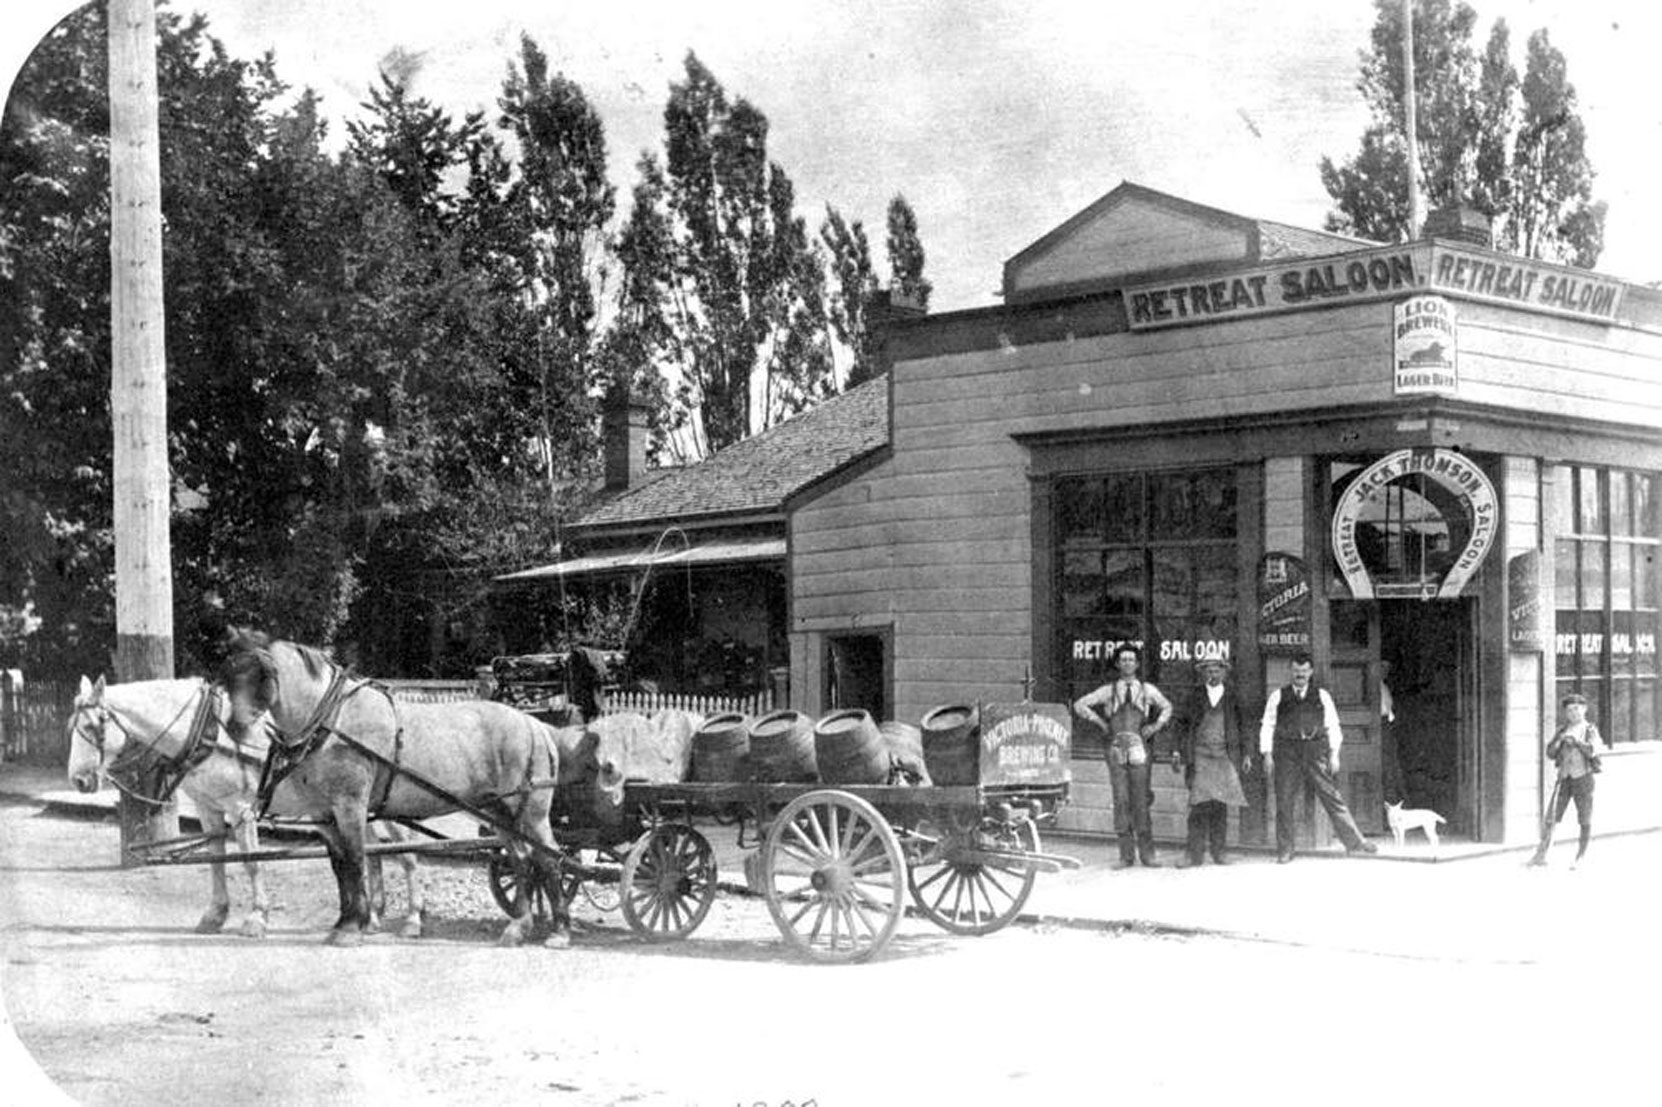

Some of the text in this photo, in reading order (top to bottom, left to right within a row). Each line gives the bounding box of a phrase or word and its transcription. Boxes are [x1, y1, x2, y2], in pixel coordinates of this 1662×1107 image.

[1132, 254, 1425, 323] RETREAT SALOON.
[1437, 253, 1617, 316] RETREAT SALOON
[1355, 465, 1394, 502] JACK
[1458, 502, 1492, 570] SALOON
[1073, 639, 1230, 661] RETRT SALOON
